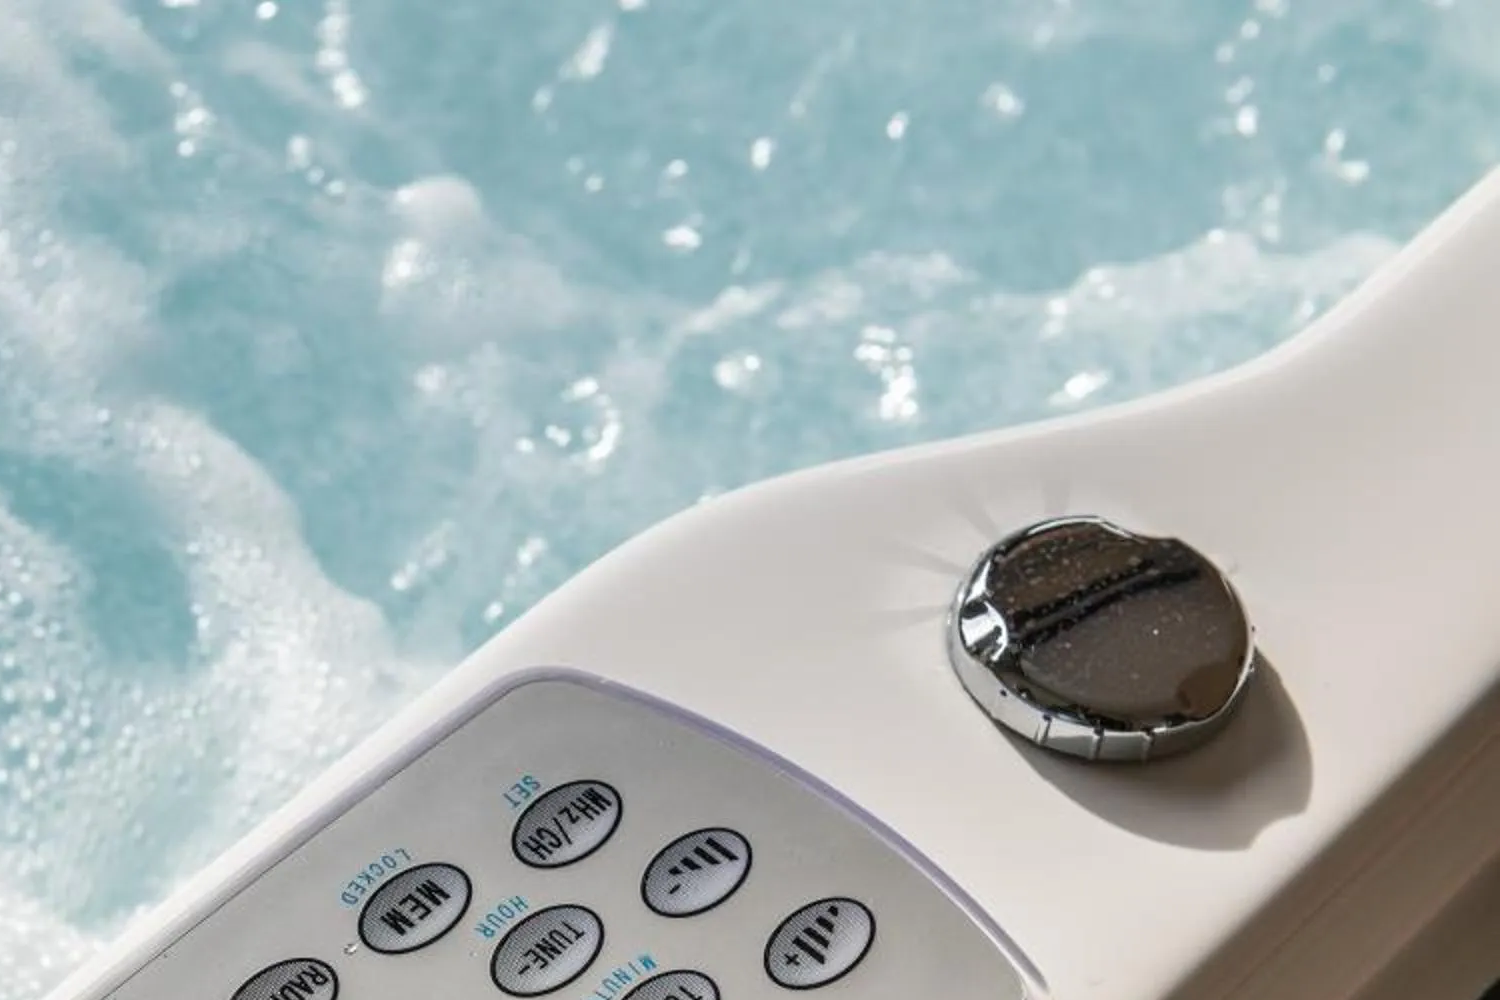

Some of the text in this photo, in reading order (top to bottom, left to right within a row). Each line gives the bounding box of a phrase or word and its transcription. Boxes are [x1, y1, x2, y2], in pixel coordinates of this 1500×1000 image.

[504, 776, 541, 808] SET
[341, 848, 412, 904] LOCKED
[381, 880, 451, 936] MEM
[475, 895, 529, 938] HOUR
